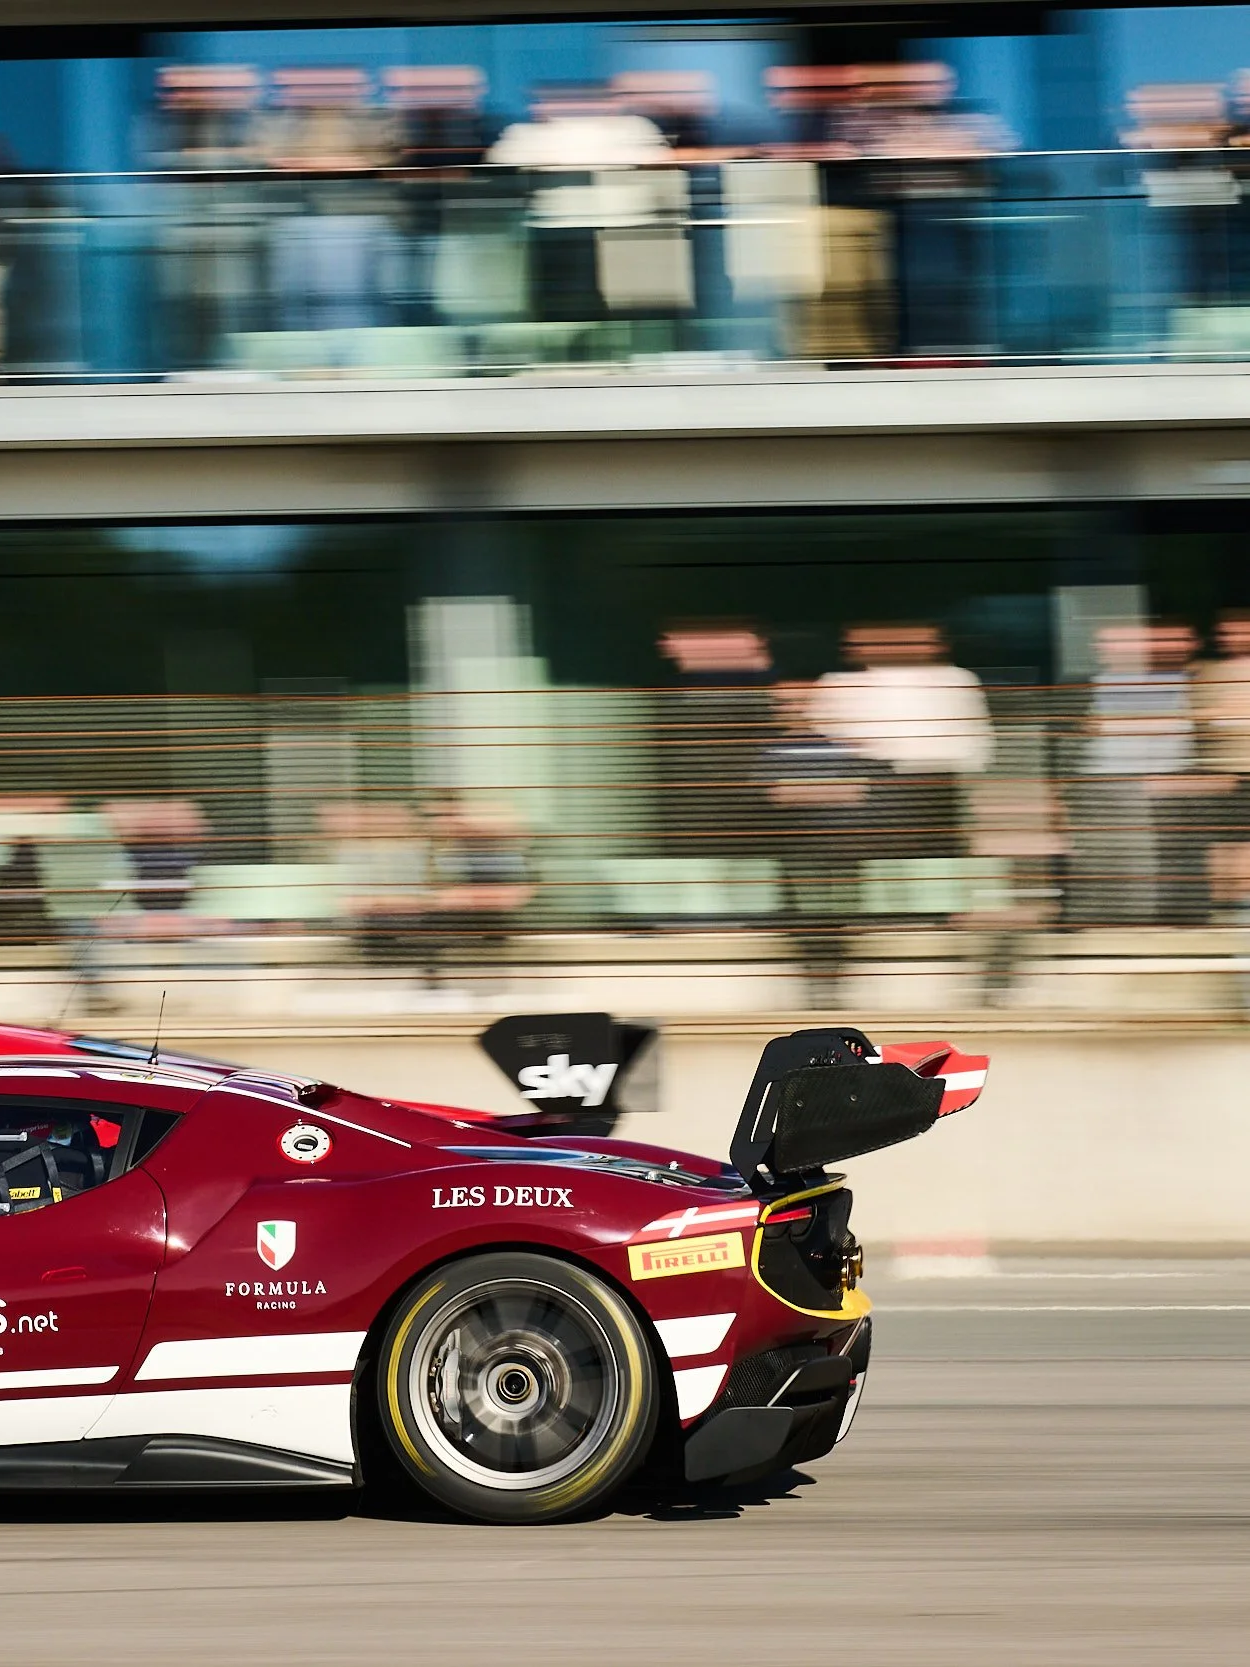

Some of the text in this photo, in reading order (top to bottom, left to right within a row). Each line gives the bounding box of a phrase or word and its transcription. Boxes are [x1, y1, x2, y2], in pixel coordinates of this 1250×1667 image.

[517, 1054, 619, 1107] sky
[431, 1186, 575, 1209] LES DEUX
[641, 1241, 728, 1271] PIRELLI
[225, 1280, 327, 1297] FORMULA
[256, 1300, 296, 1310] RACING
